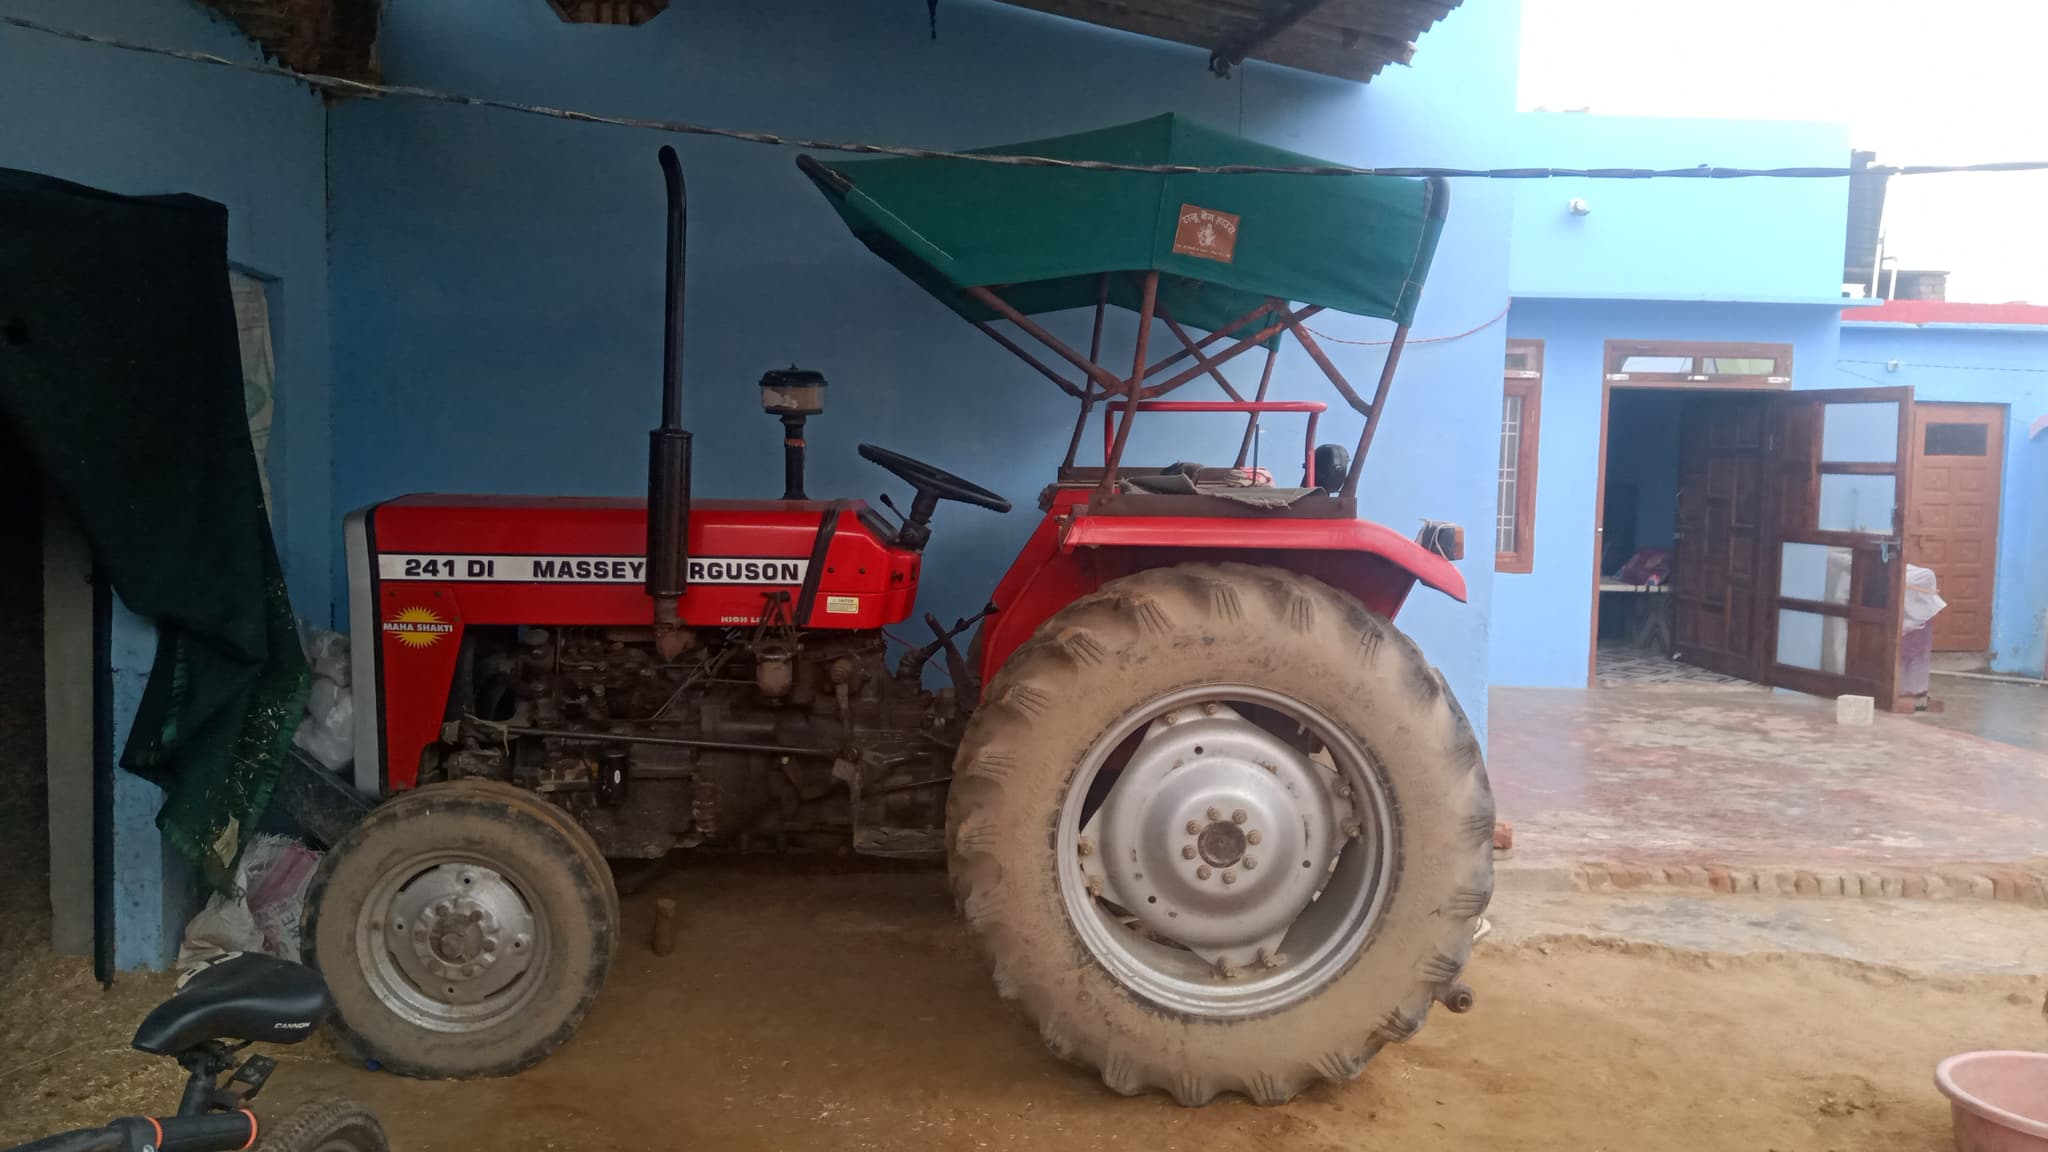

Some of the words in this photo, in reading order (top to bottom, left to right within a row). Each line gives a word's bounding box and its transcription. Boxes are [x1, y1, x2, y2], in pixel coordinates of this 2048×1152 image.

[405, 559, 455, 577] 241
[467, 560, 494, 578] DI
[533, 560, 644, 579] MASSEY
[689, 562, 799, 581] RGUSON
[383, 623, 414, 631] MAHA
[417, 624, 453, 632] SHAKTI
